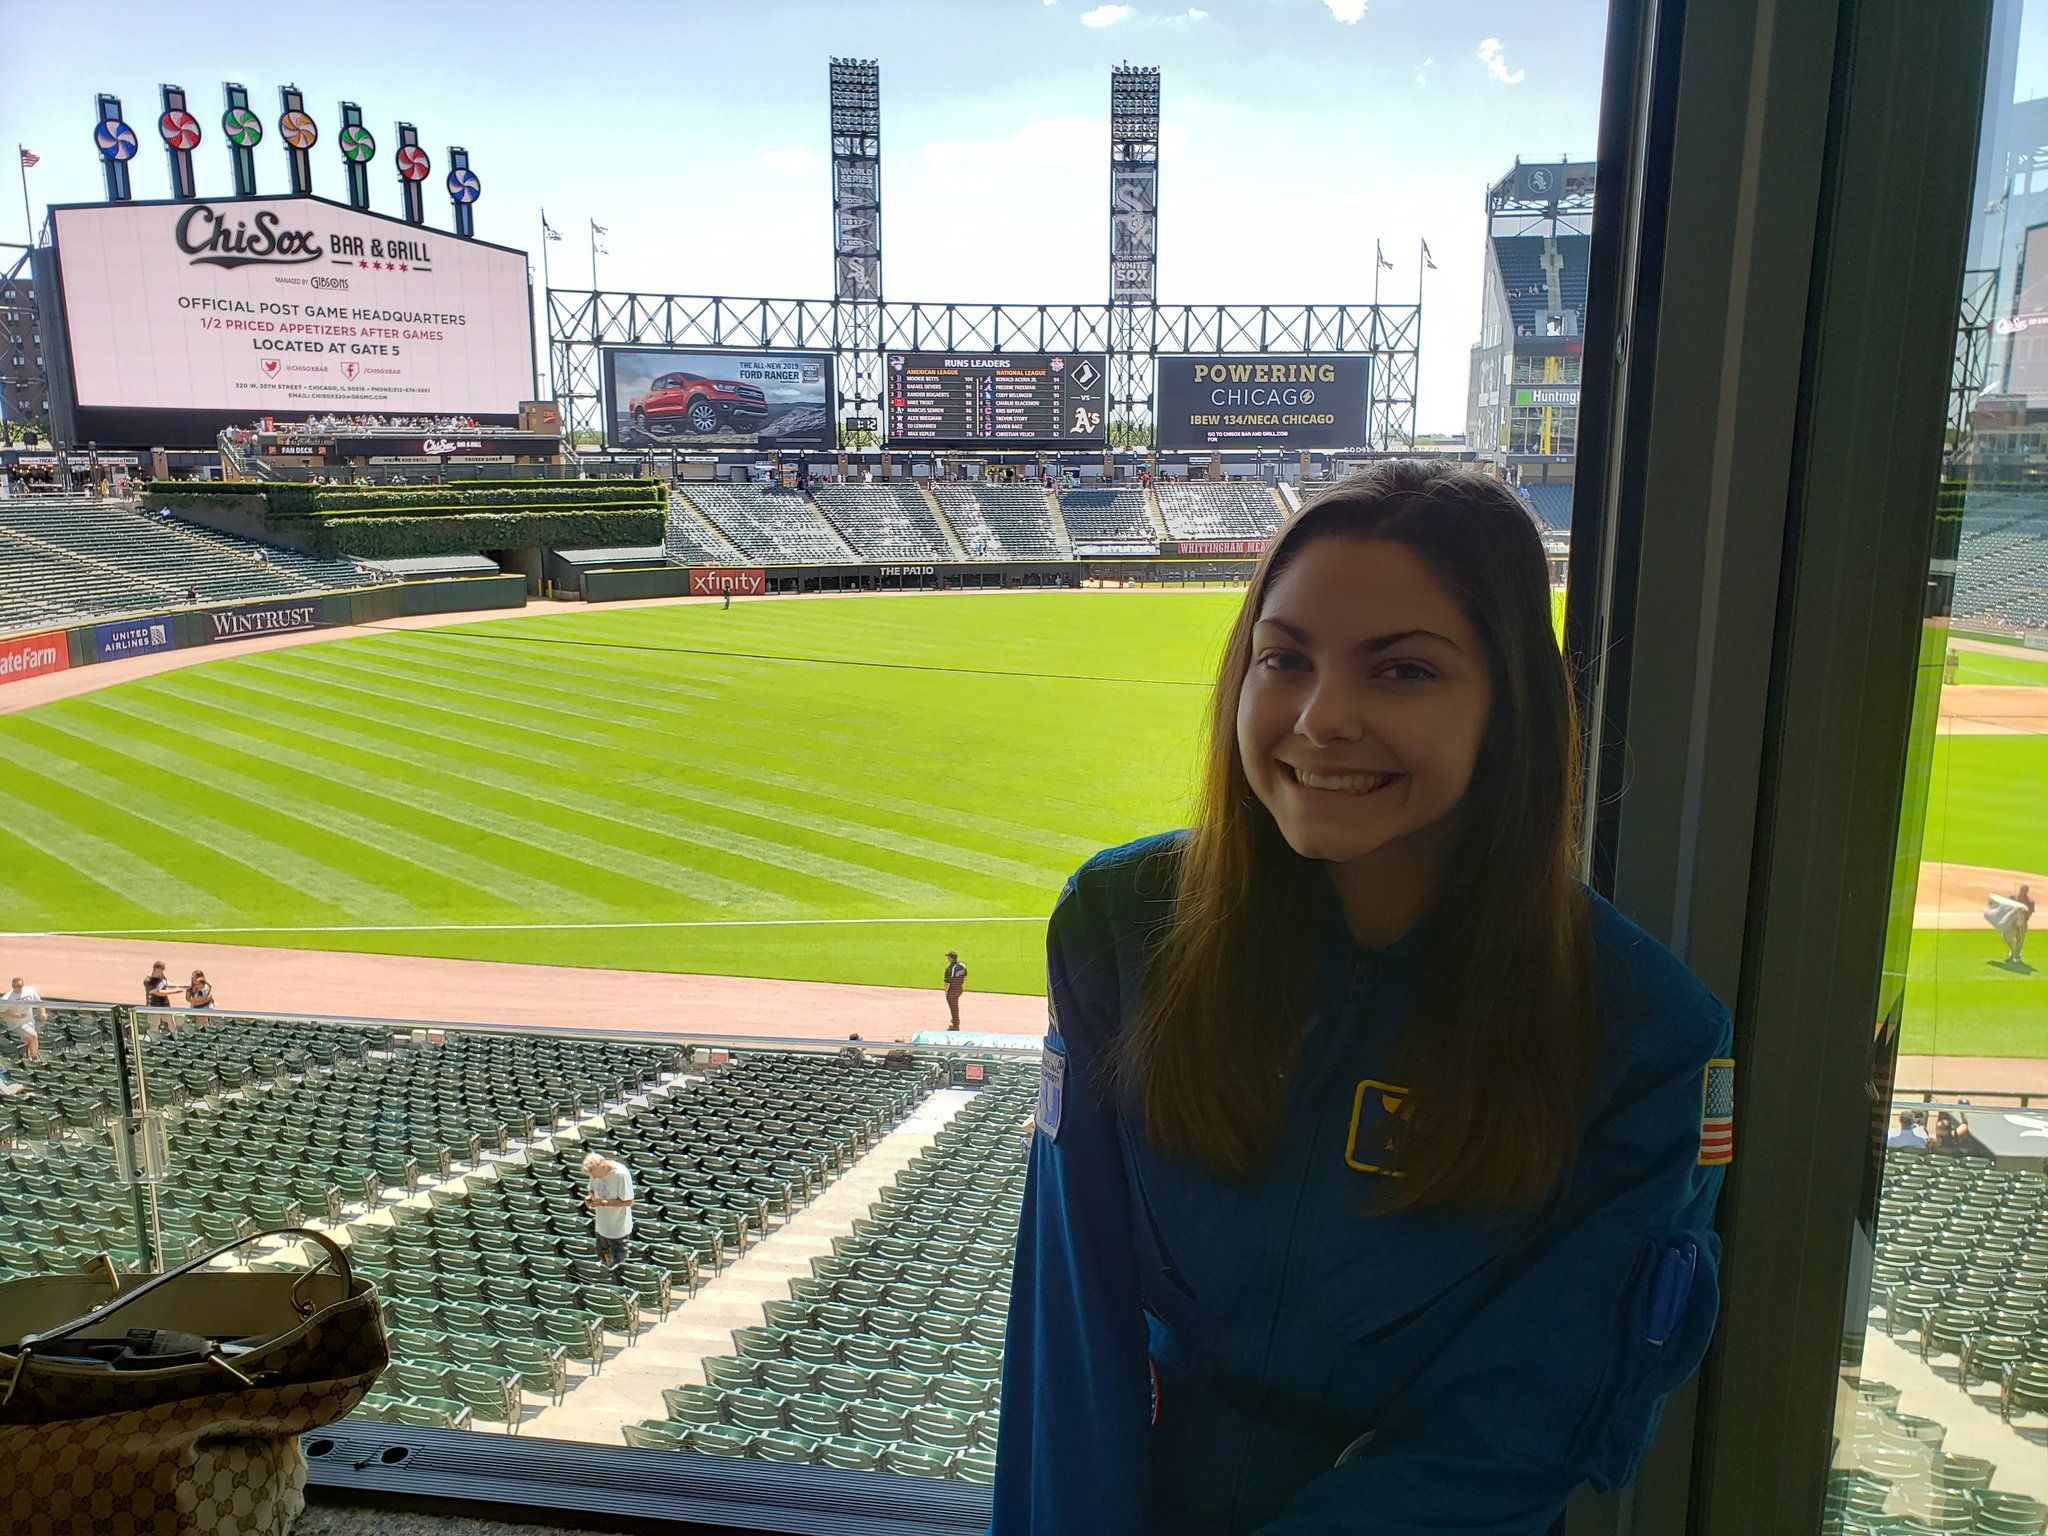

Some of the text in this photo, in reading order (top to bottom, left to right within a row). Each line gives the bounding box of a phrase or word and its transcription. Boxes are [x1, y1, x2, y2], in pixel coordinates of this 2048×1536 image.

[840, 168, 873, 176] WORLD
[840, 175, 873, 184] SERIES
[176, 205, 431, 266] ChiSox BAR & GRILL
[1115, 262, 1148, 270] WHITE
[275, 276, 301, 285] MANAGED
[311, 276, 349, 290] GIBSONS
[1116, 270, 1148, 282] SOX
[178, 296, 466, 326] OFFICIAL POST GAME HEADQUARTERS
[201, 317, 443, 341] 1/2 PRICED APPETIZERS AFTER GAMES
[253, 338, 400, 356] LOCATED AT GATE 5
[739, 361, 752, 369] THE
[753, 362, 782, 370] ALL-NEW
[944, 360, 1011, 368] RUNS LEADERS
[740, 370, 763, 379] FORD
[764, 371, 800, 380] RANGER
[1194, 364, 1336, 383] POWERING
[1211, 388, 1315, 406] CHICAGO
[1190, 414, 1334, 426] IBEW 134/NECA CHICAGO
[281, 446, 295, 454] FAN
[296, 446, 313, 454] DECK
[1181, 541, 1244, 555] WHITTINGHAM
[880, 566, 934, 576] THE PATIO
[694, 570, 762, 595] xfinity
[212, 606, 314, 636] WINTRUST
[113, 628, 148, 642] UNITED
[105, 636, 150, 653] AIRLINES
